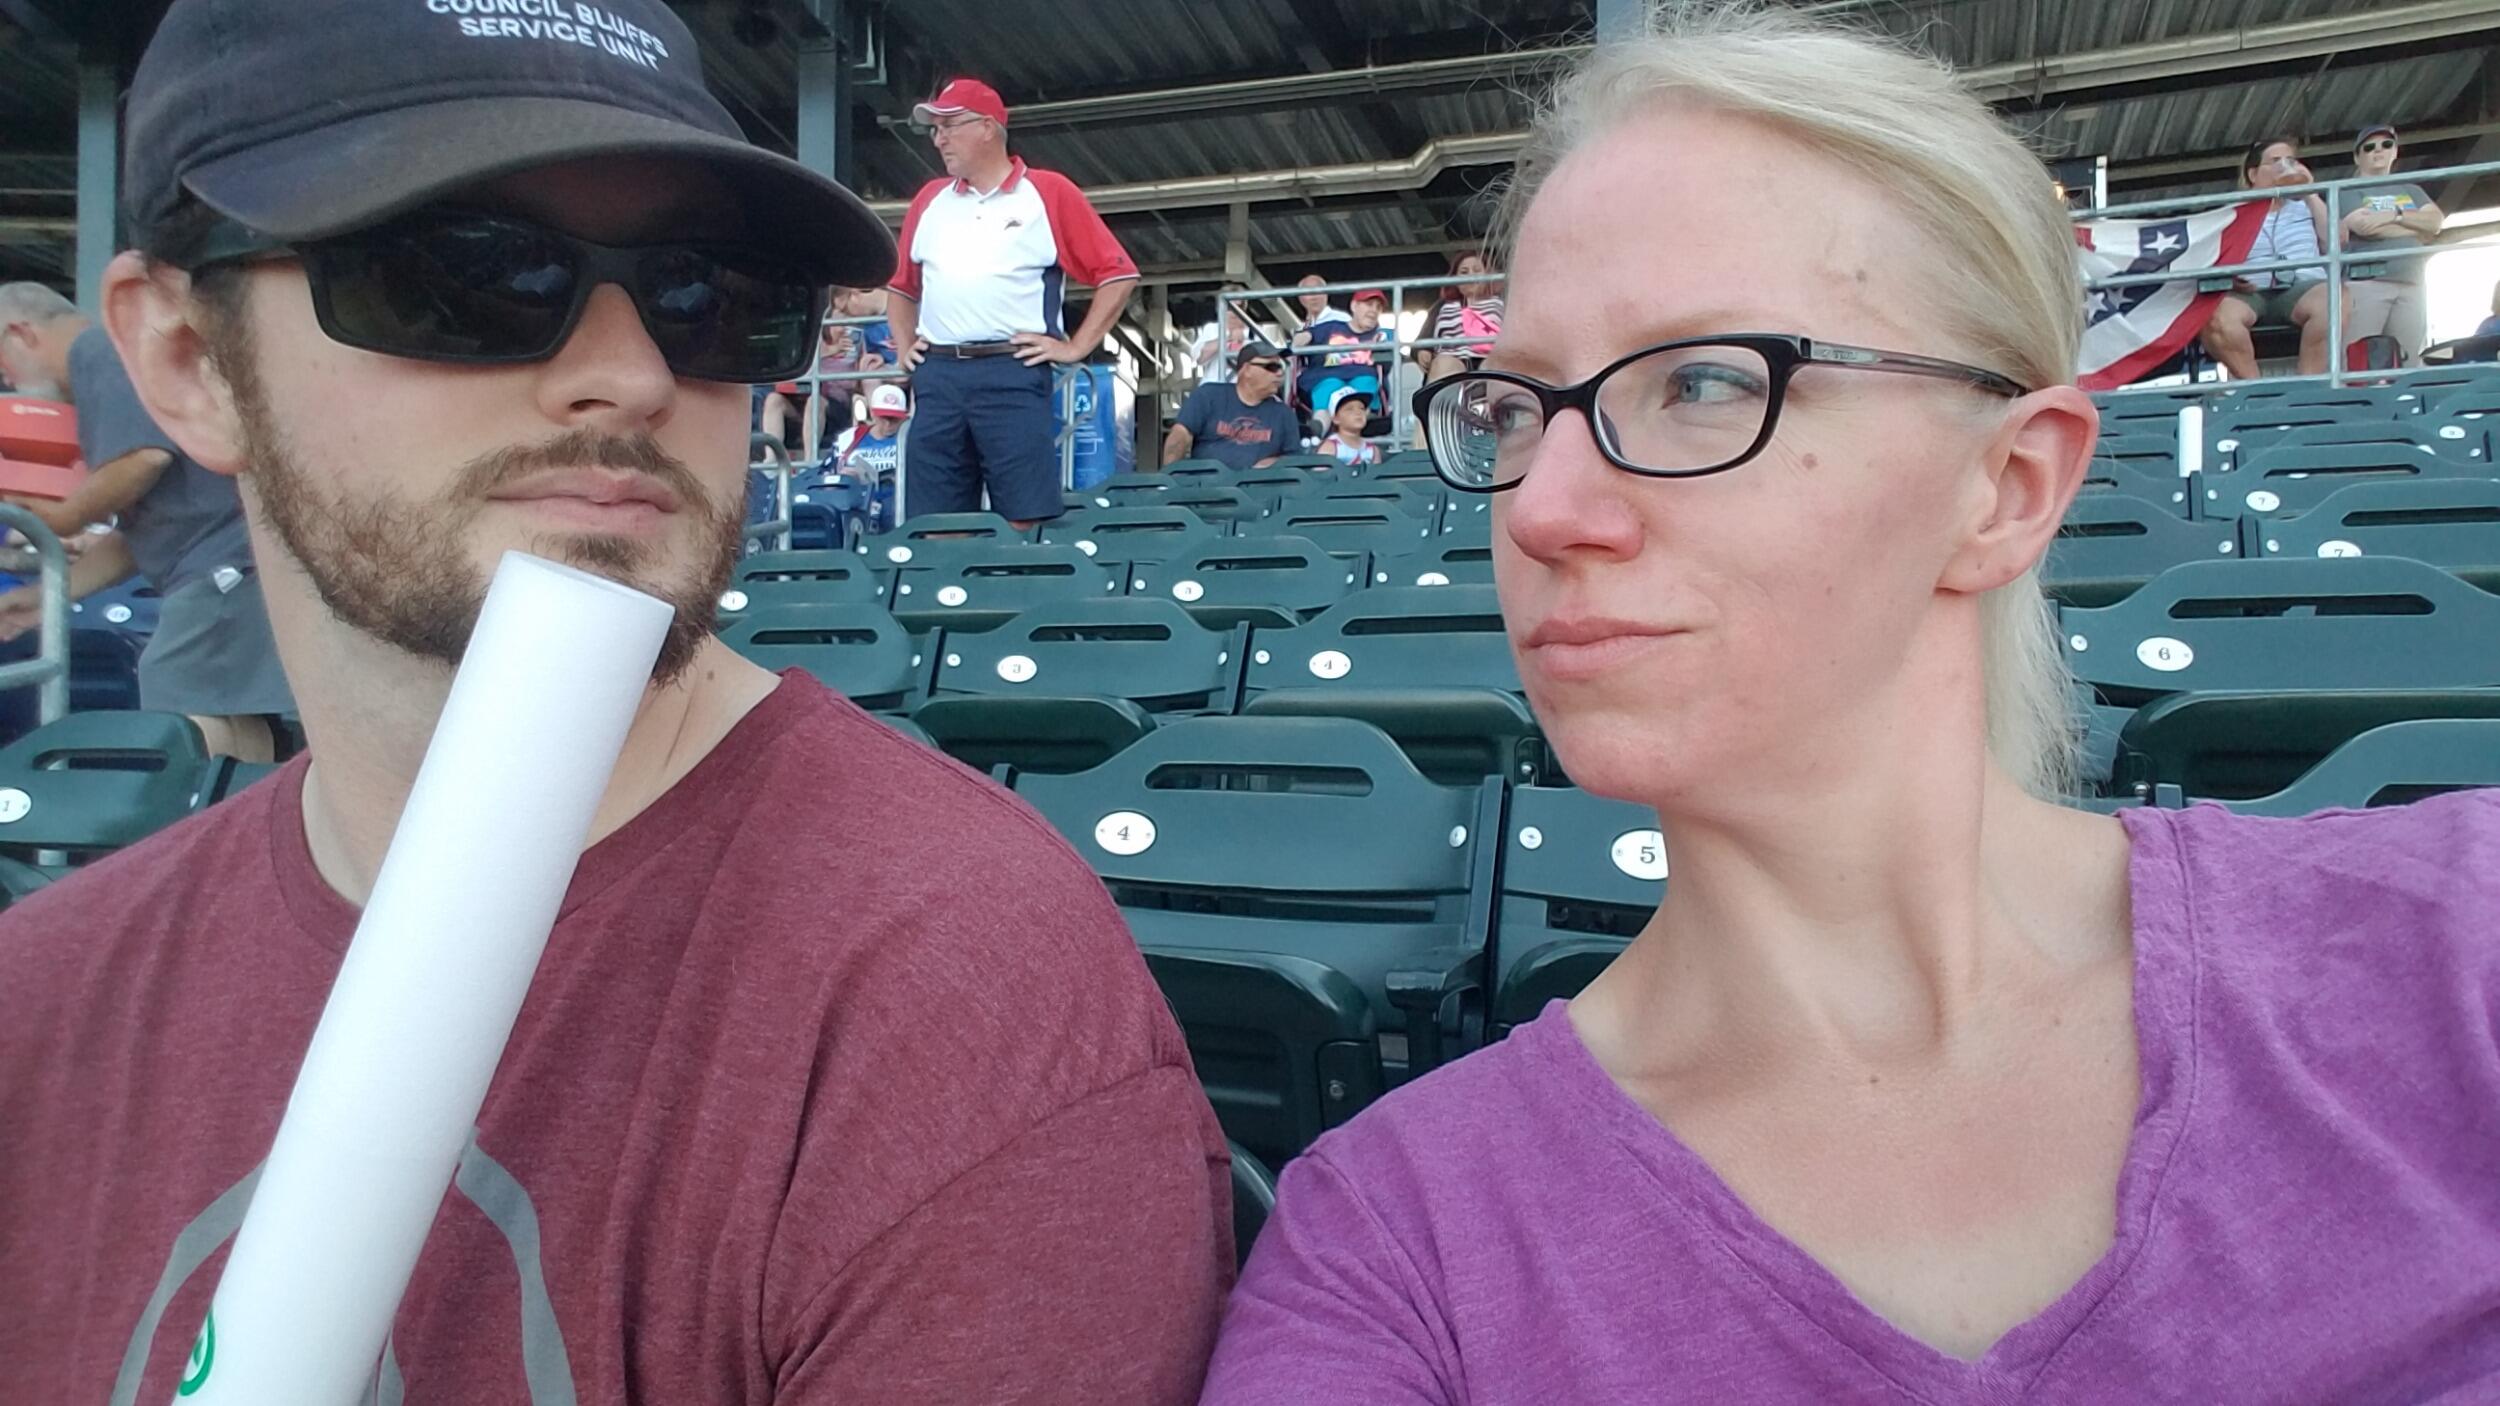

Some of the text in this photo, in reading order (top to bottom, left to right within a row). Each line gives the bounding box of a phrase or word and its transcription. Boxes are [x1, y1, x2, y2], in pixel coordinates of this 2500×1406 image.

[427, 0, 669, 58] COUNCIL BLUFFS
[459, 17, 660, 71] SERVICE UNIT
[1117, 825, 1130, 841] 4
[1640, 846, 1656, 864] 5
